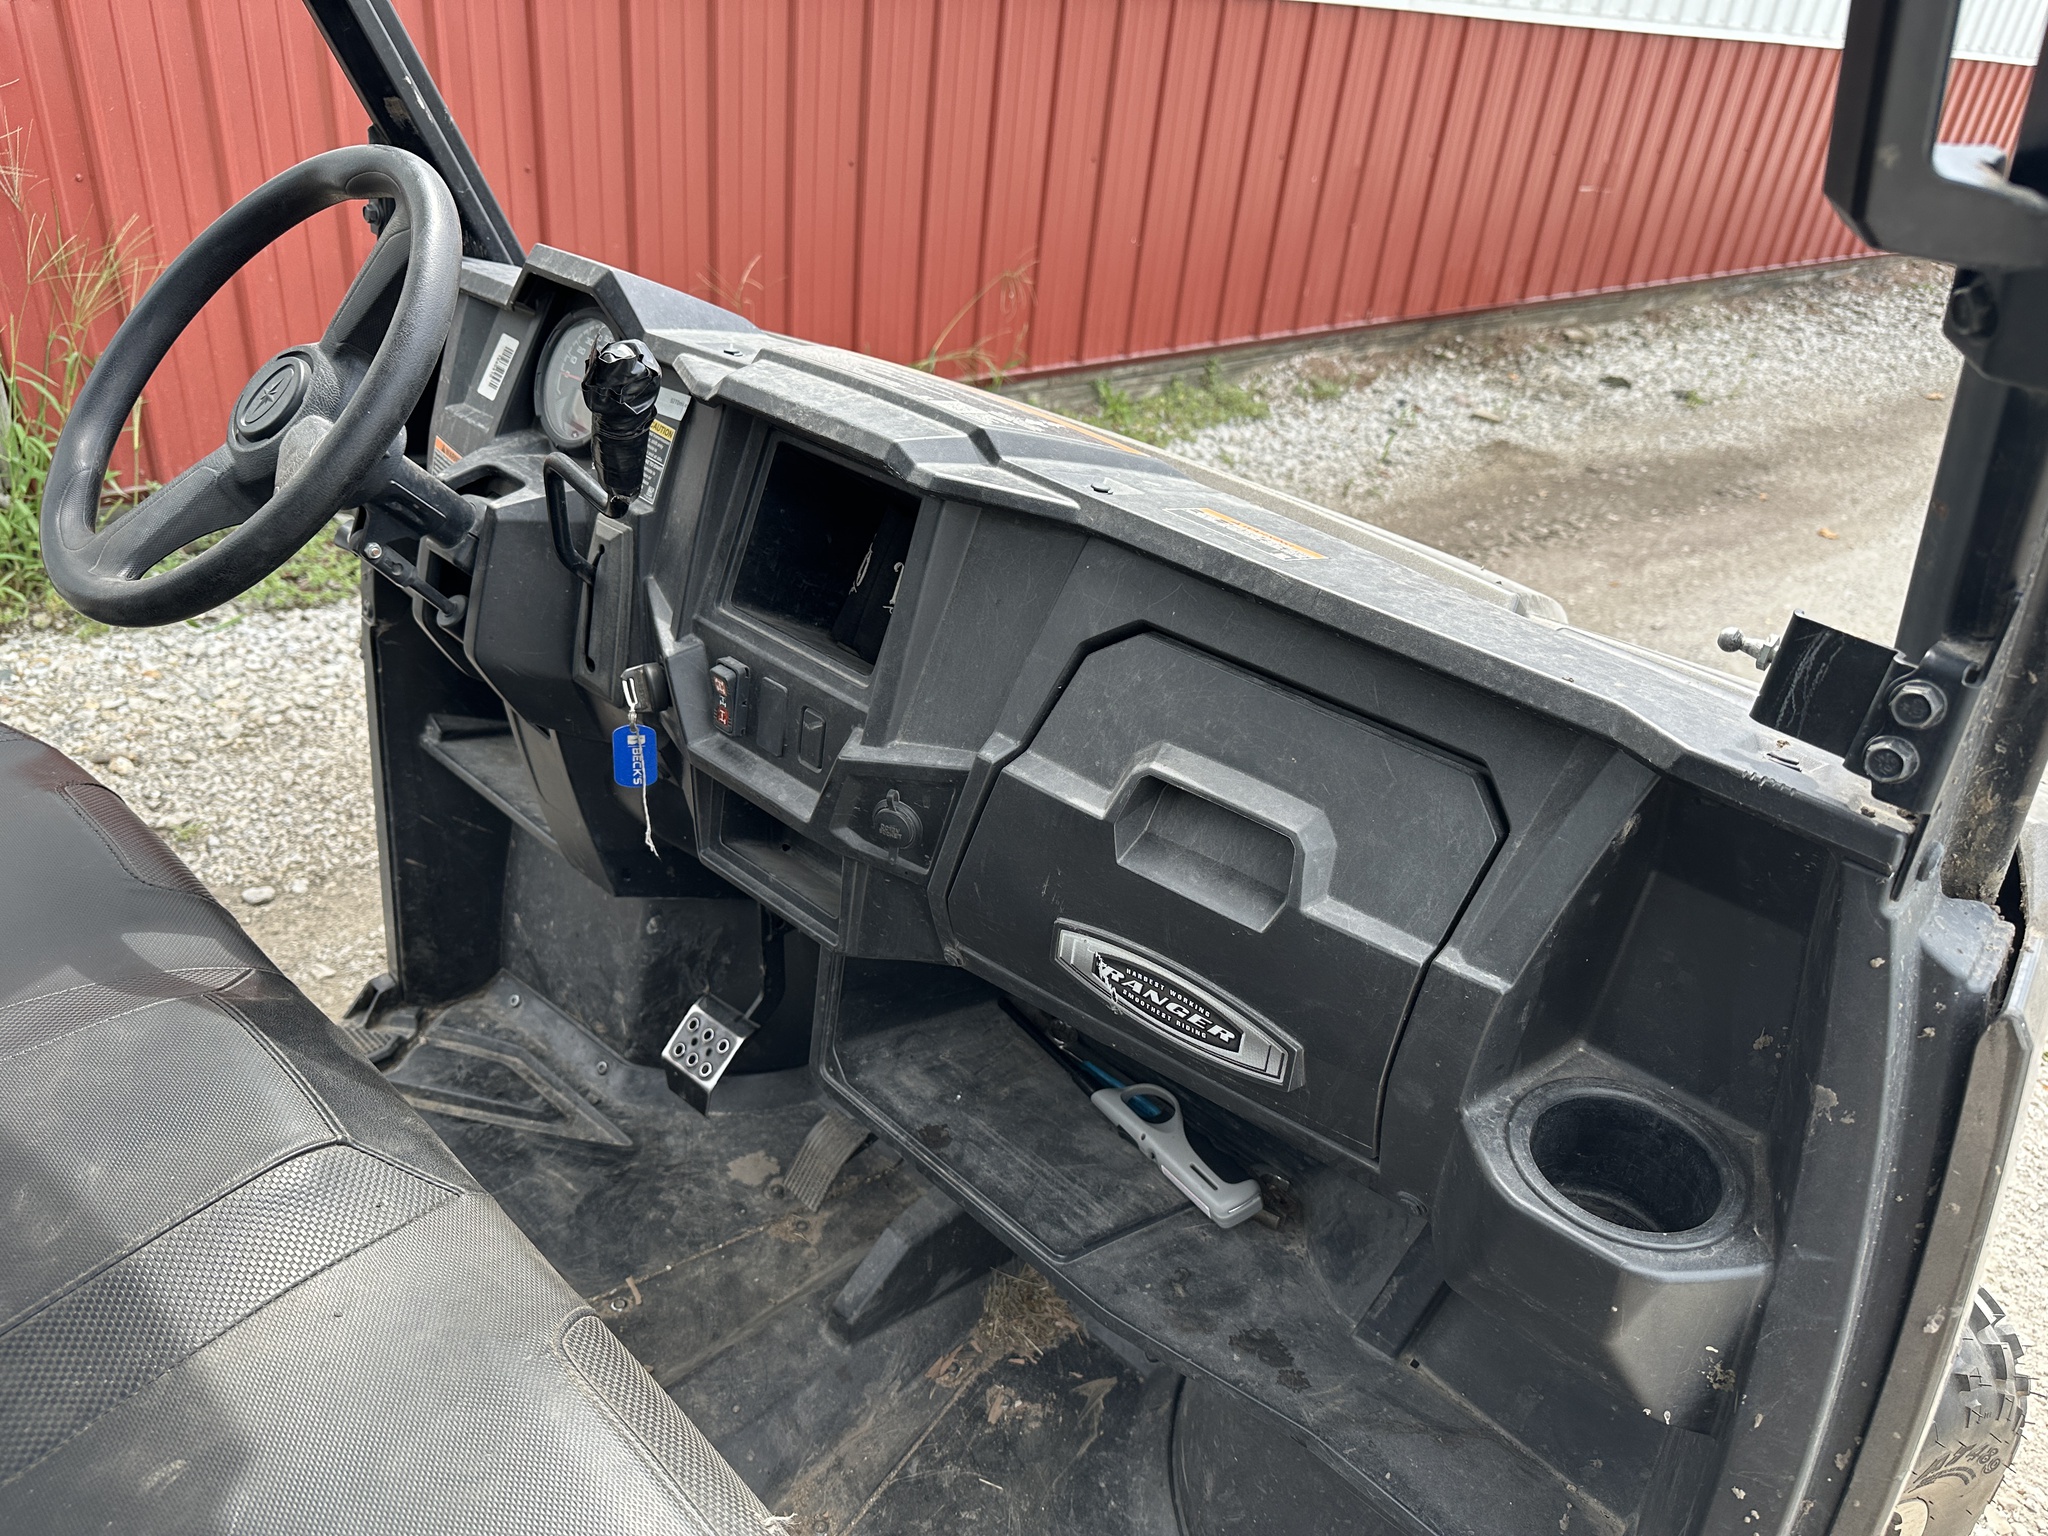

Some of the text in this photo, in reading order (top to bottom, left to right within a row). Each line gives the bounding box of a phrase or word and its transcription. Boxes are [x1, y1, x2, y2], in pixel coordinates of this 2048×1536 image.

[632, 747, 644, 785] BECK'S
[1100, 963, 1236, 1044] RANGER
[1122, 989, 1208, 1039] SMOOTHEST RIDING
[1126, 966, 1211, 1018] HARDEST WORKING
